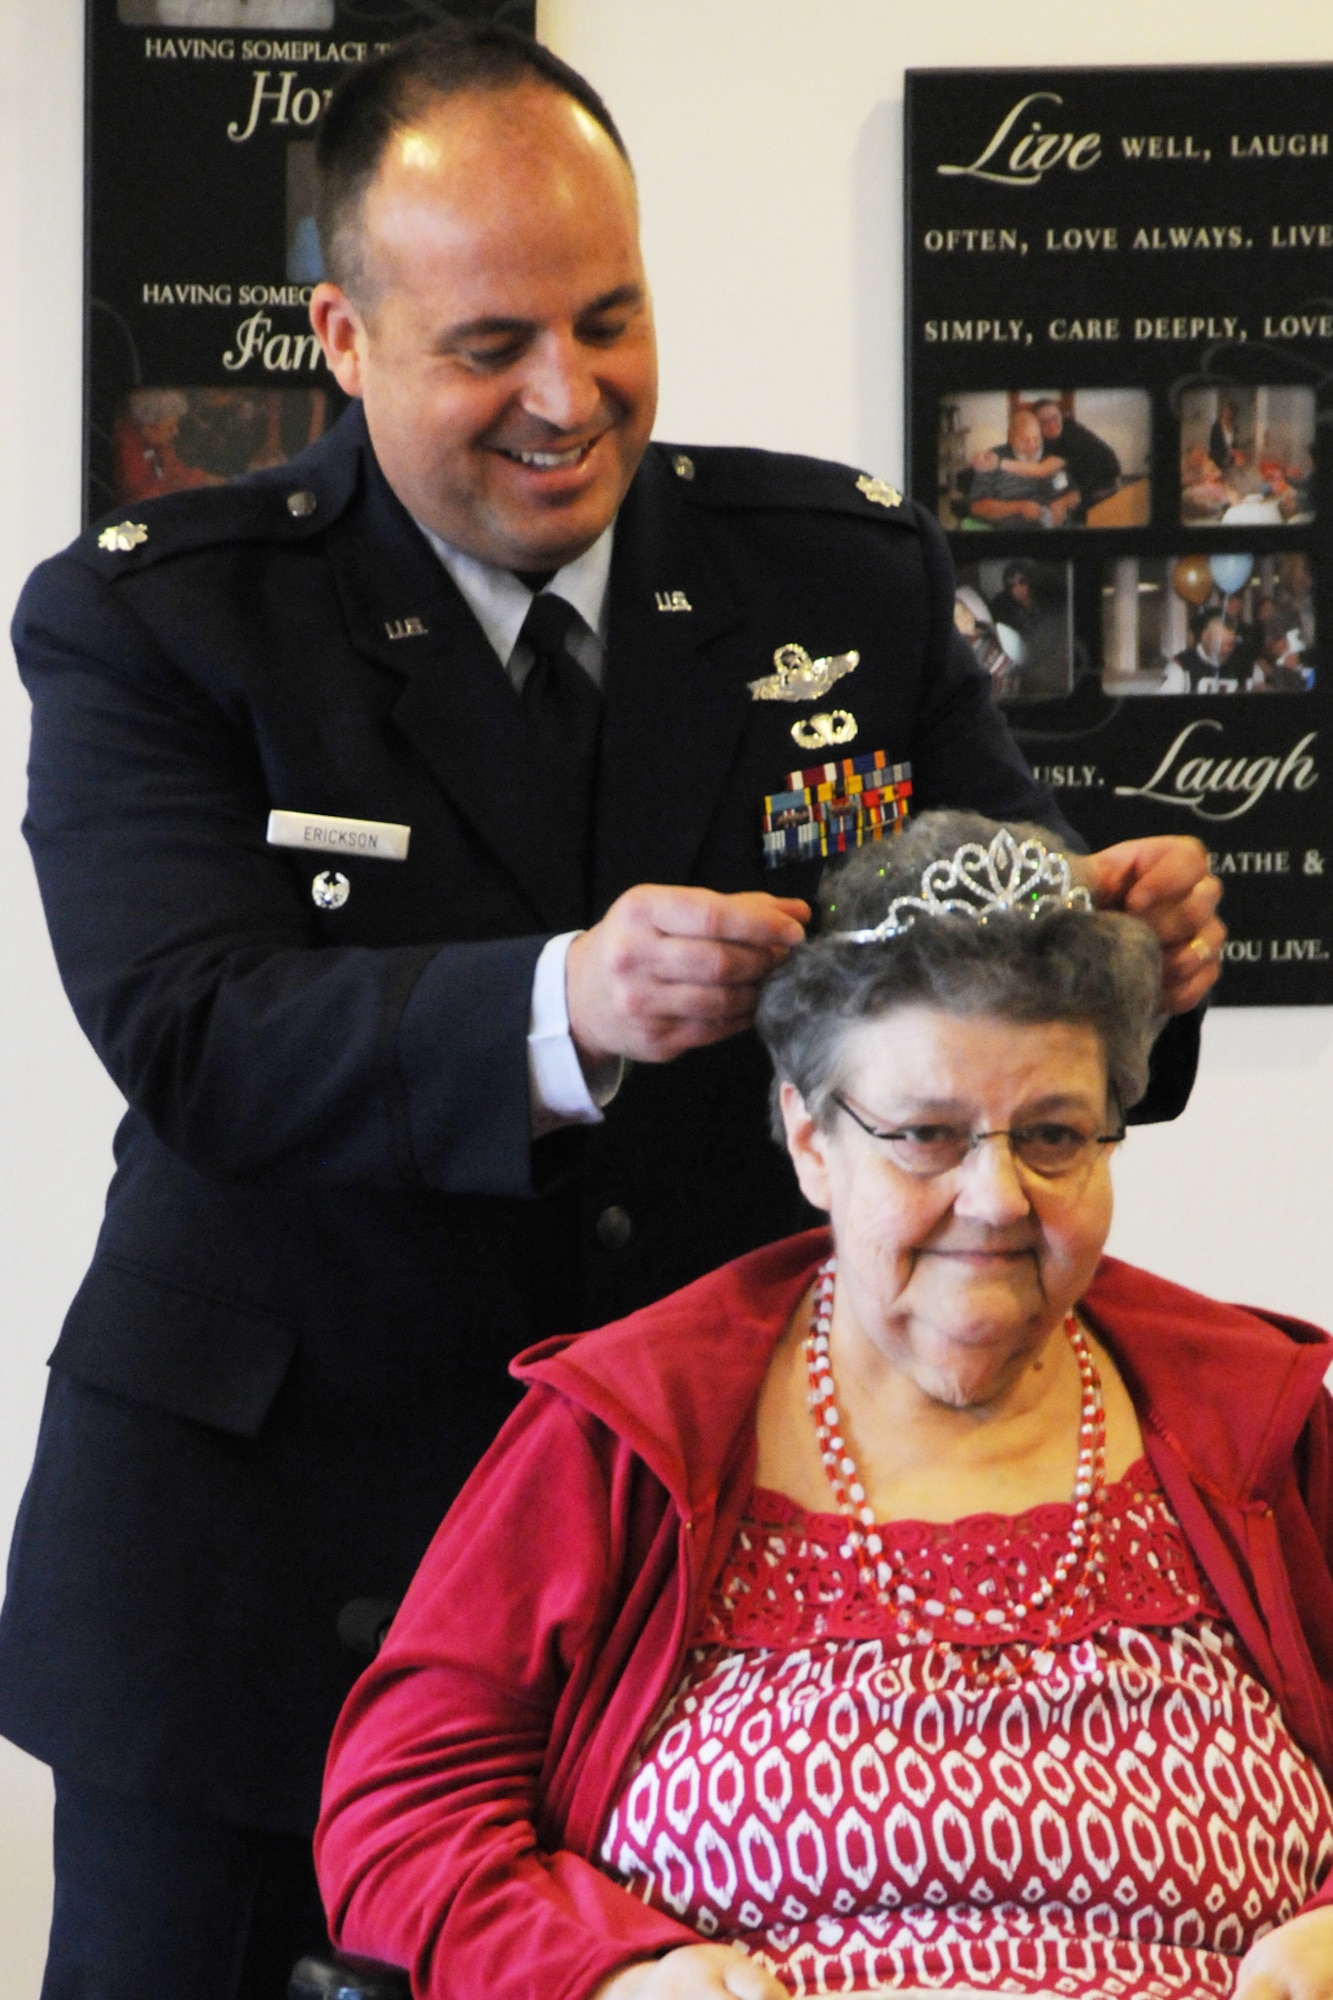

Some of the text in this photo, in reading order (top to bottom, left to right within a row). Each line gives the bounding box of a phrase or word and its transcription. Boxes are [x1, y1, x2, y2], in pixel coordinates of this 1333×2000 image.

[145, 38, 235, 60] HAVING
[226, 70, 334, 143] Ho
[937, 91, 1329, 186] Live WELL, LAUGH
[924, 225, 1333, 255] OFTEN, LOVE ALWAYS. LIVE
[142, 284, 316, 307] HAVING SOMEO
[222, 309, 325, 372] Fam
[924, 315, 1333, 345] SIMPLY, CARE DEEPLY, LOVE
[1032, 718, 1318, 820] USLY. Laugh
[303, 826, 378, 849] ERICKSON
[1205, 848, 1326, 875] EATHE &
[1270, 939, 1330, 962] LIVE.
